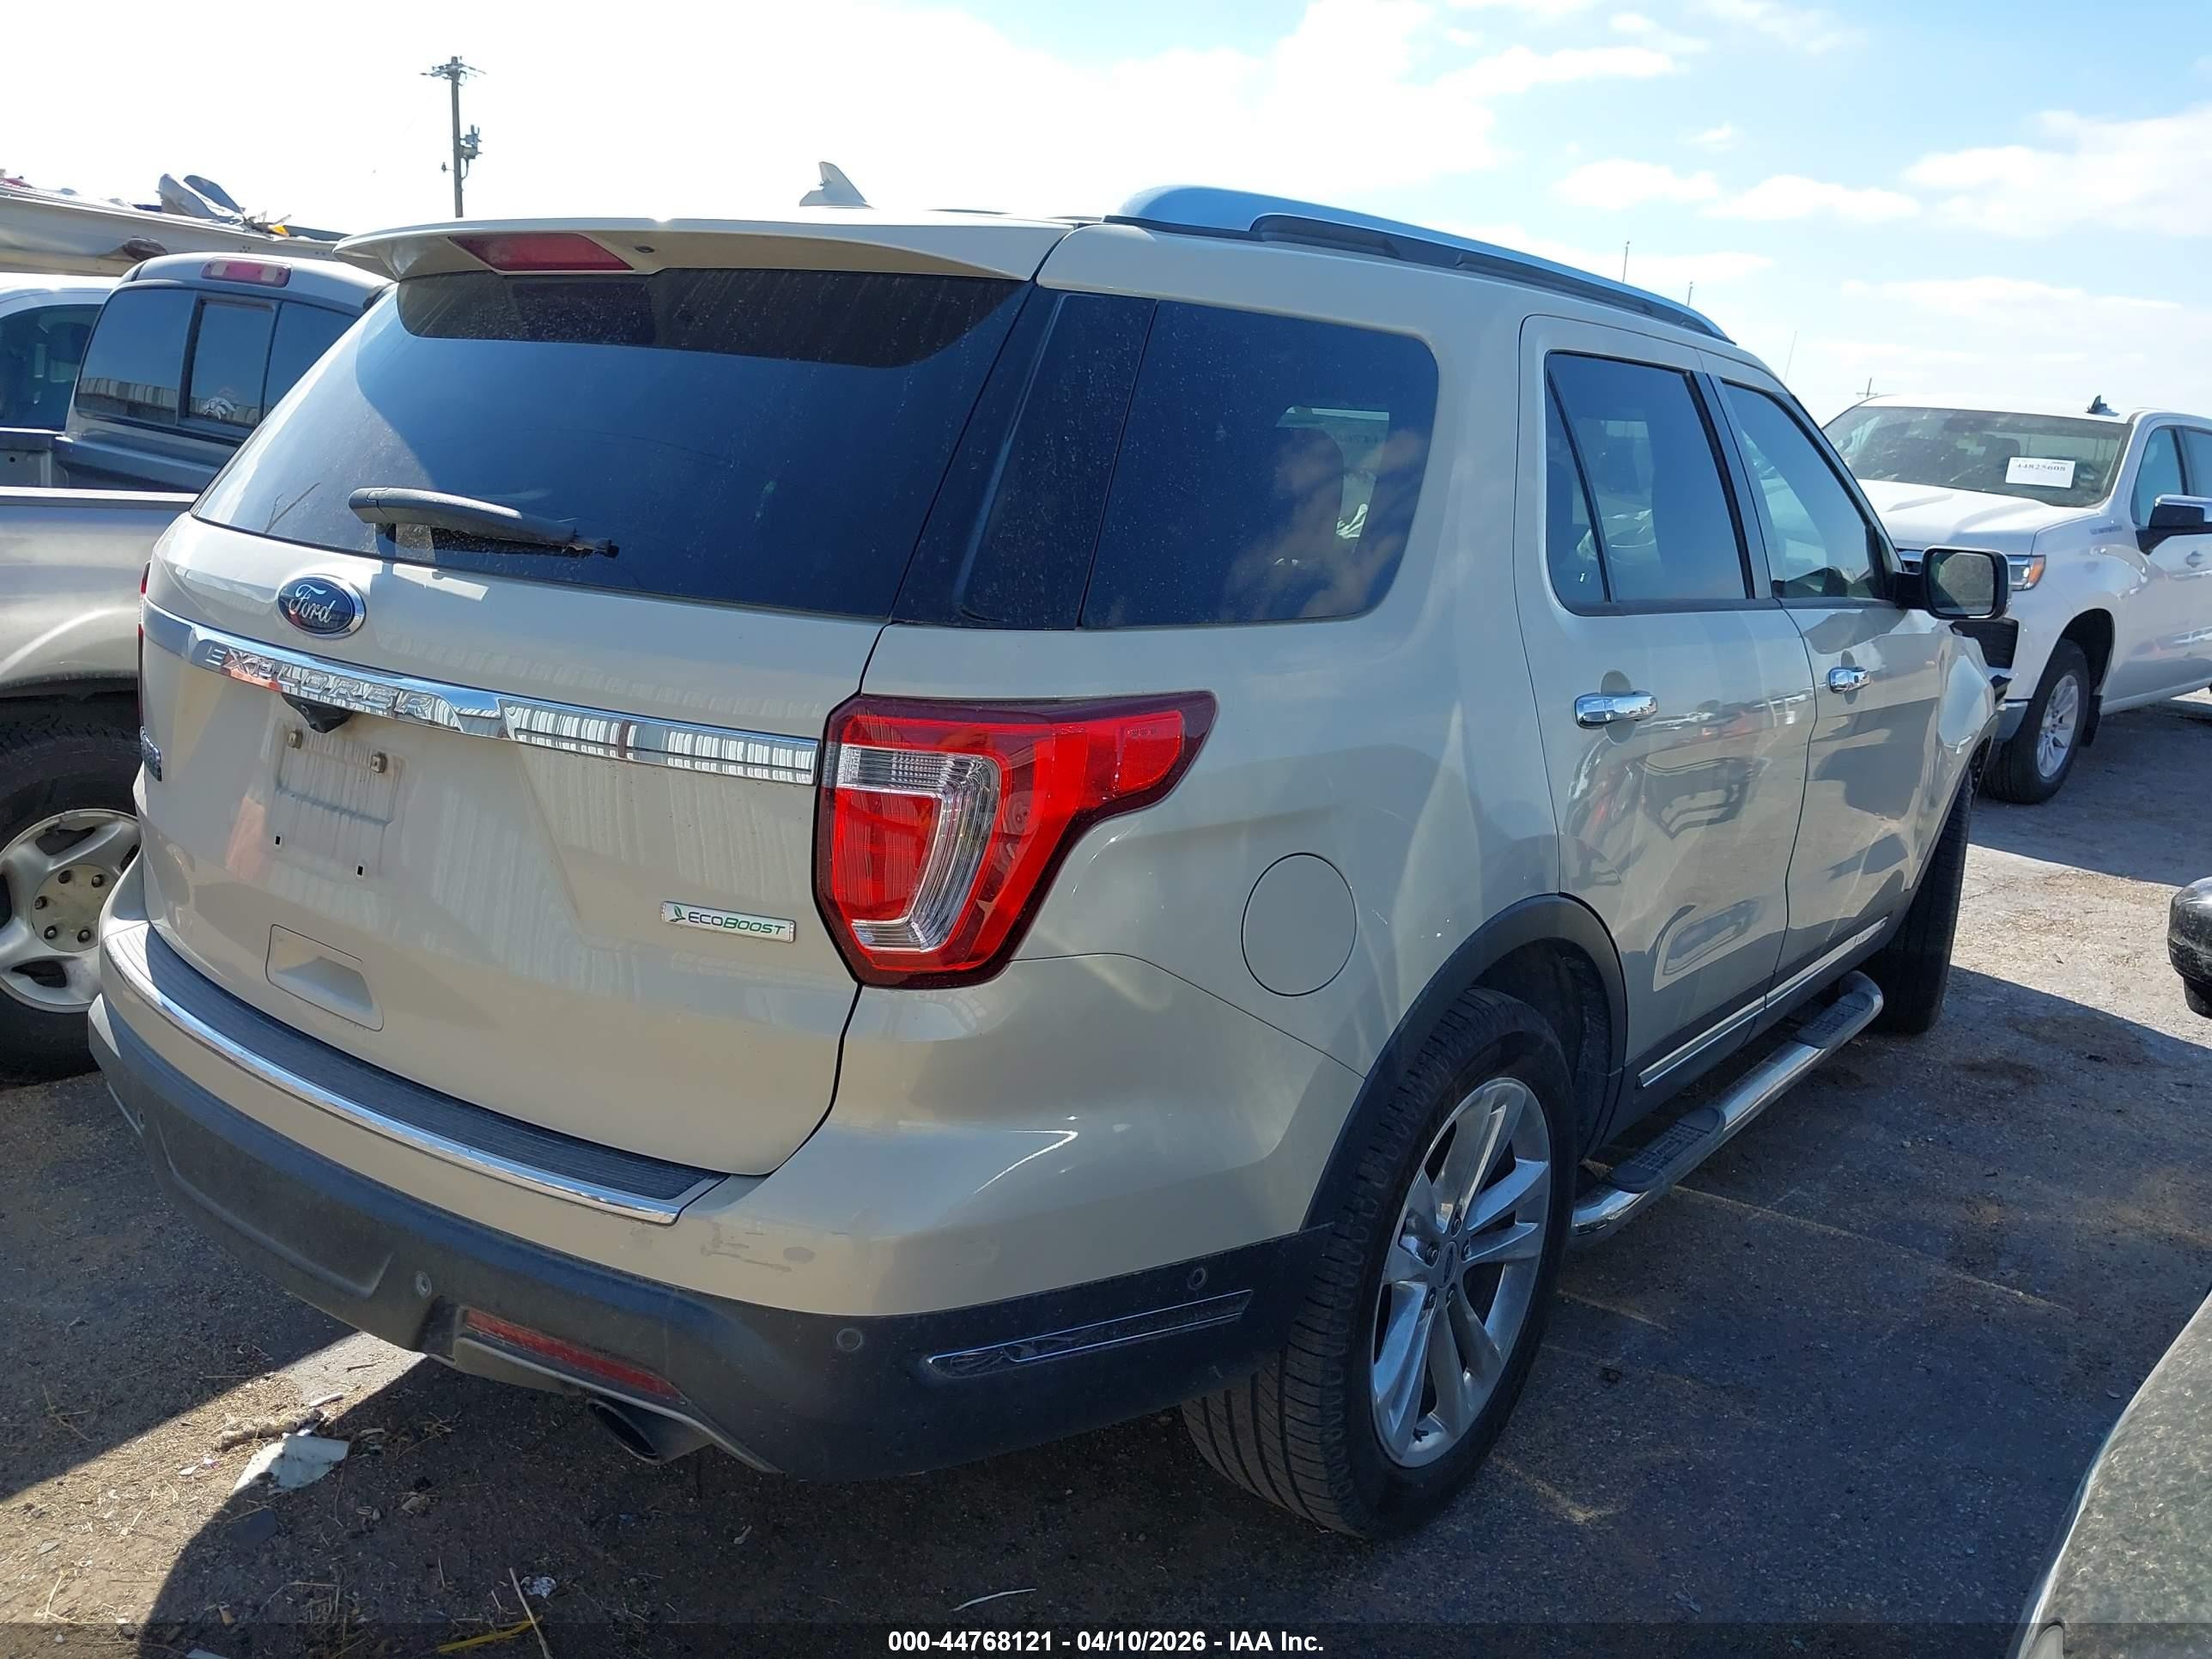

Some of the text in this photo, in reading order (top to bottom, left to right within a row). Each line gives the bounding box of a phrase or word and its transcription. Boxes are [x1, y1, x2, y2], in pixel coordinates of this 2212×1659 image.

[289, 584, 336, 623] Ford
[205, 645, 430, 718] EXPLORER
[688, 911, 786, 935] ECOBOOST
